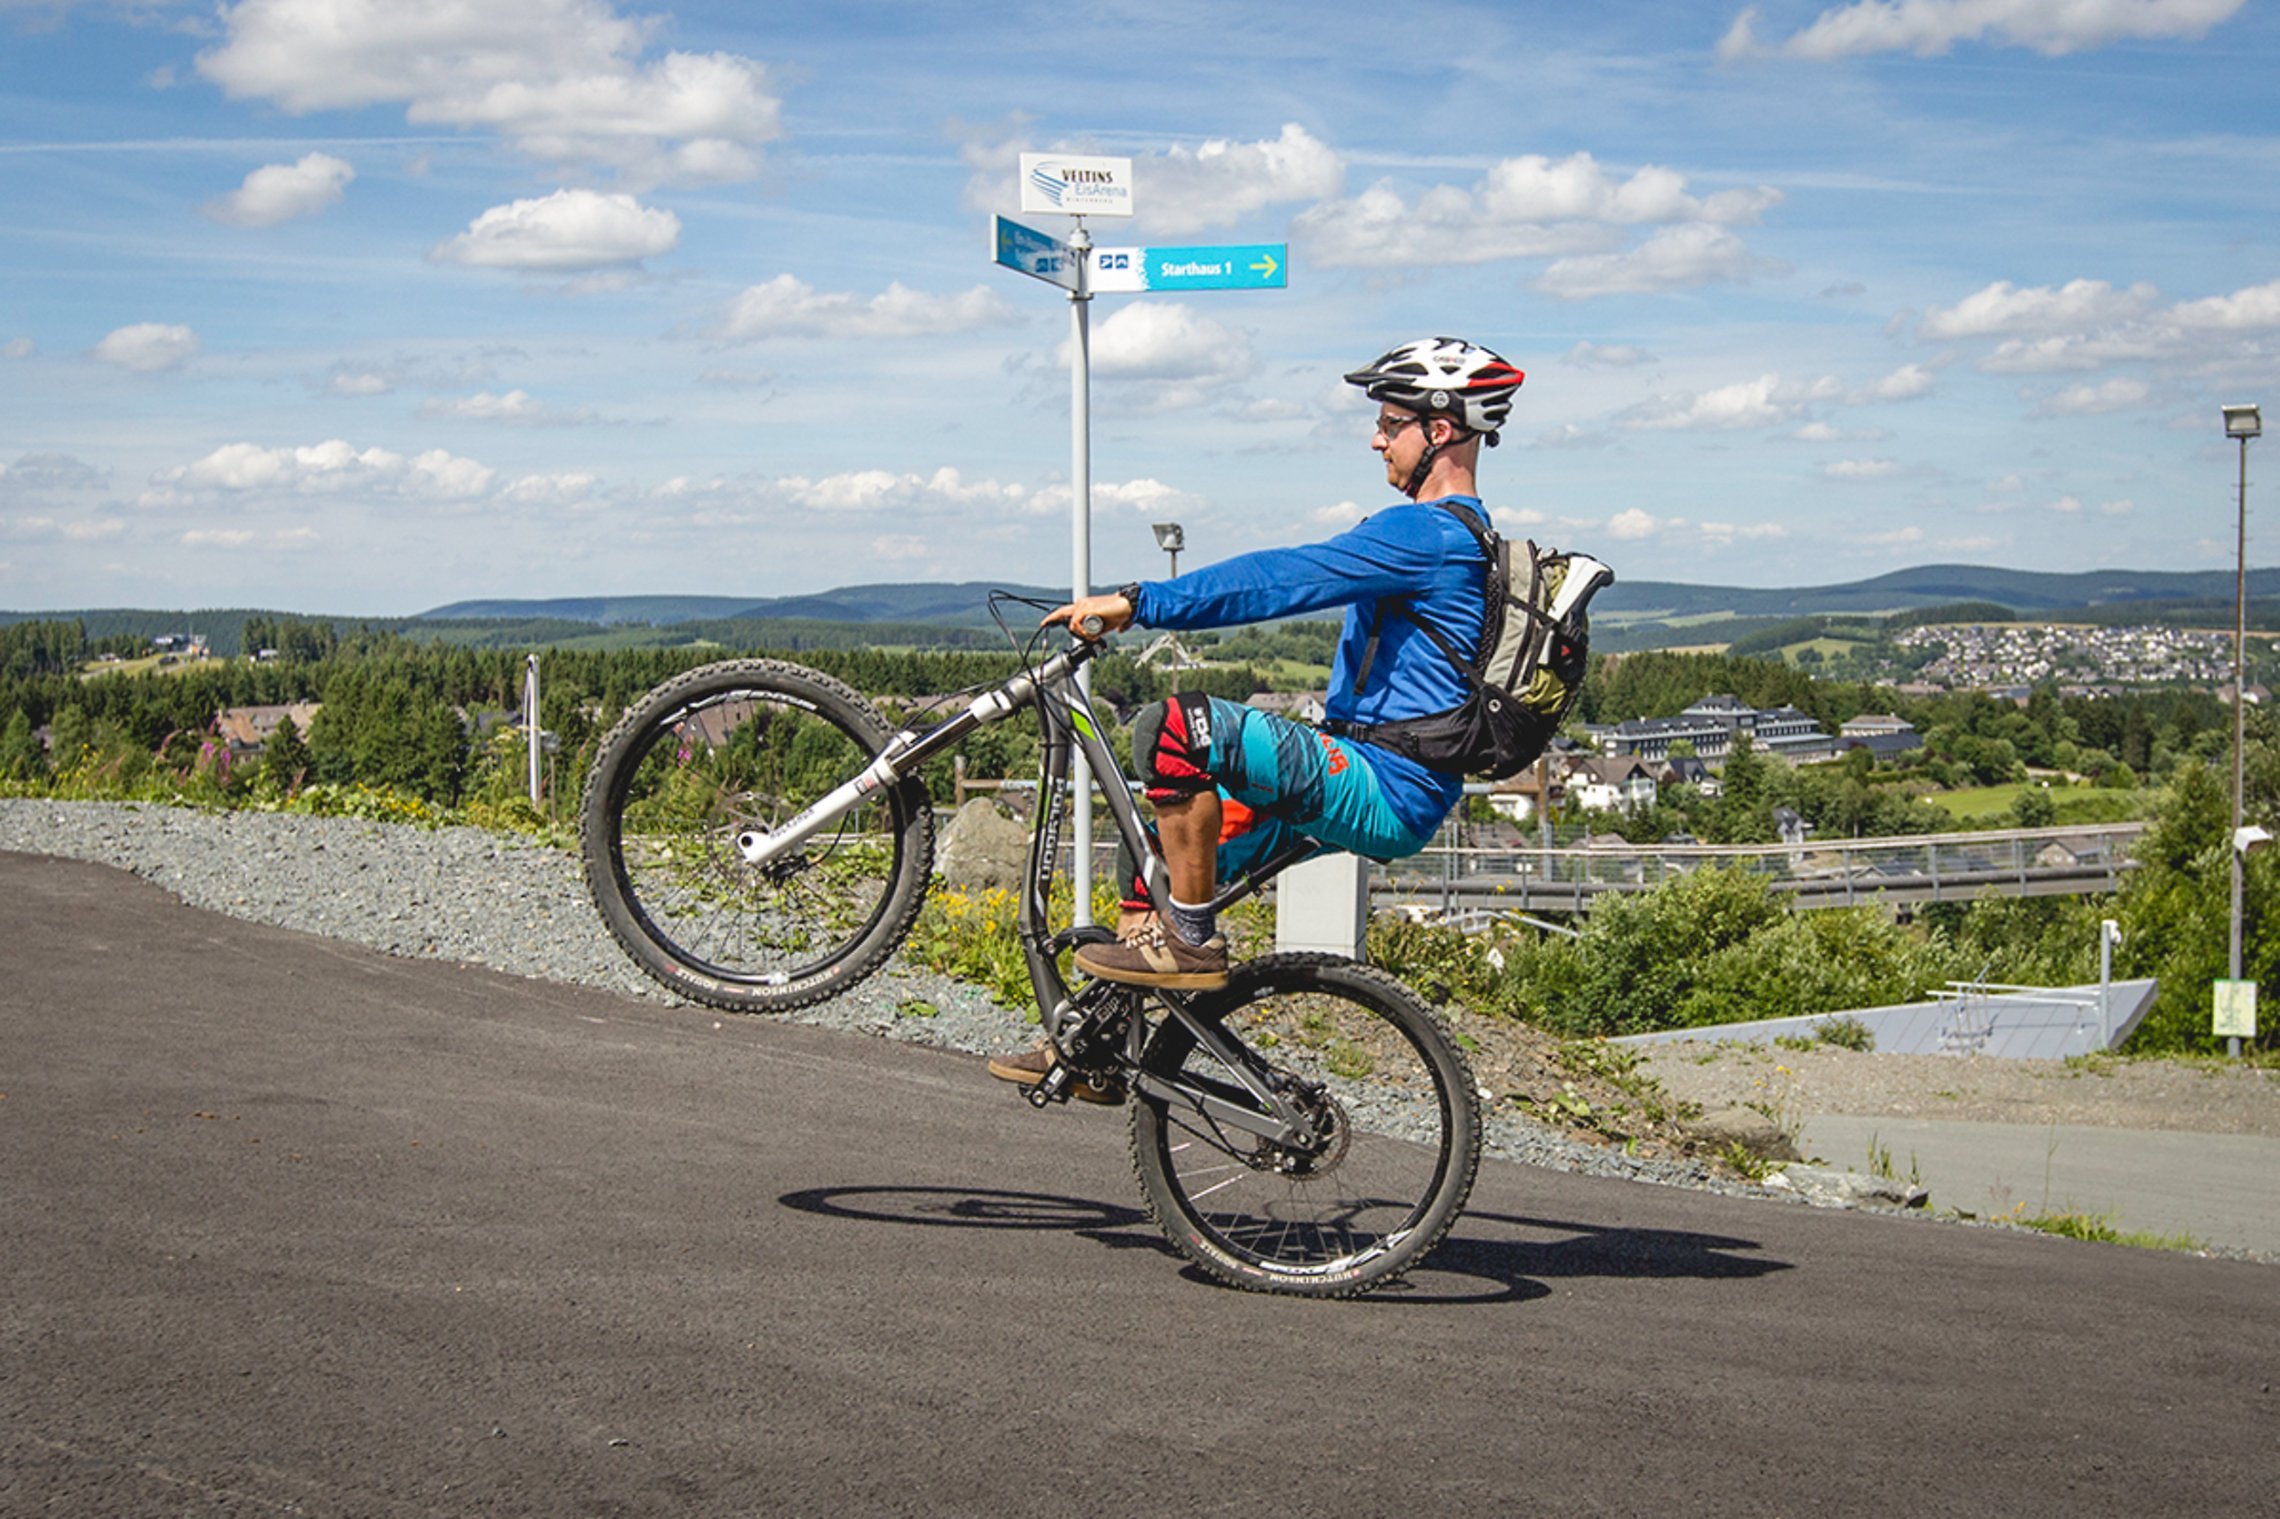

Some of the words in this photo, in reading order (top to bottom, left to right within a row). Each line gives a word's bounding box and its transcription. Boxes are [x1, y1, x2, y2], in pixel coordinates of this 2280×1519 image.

[1062, 169, 1113, 184] VELTINS
[1075, 183, 1127, 198] EisArena
[1161, 261, 1222, 278] Starthaus
[1226, 260, 1232, 275] 1
[1041, 777, 1066, 881] POLYGON
[751, 969, 834, 997] HUTCHINSON
[1269, 1270, 1353, 1286] HUTCHINSON
